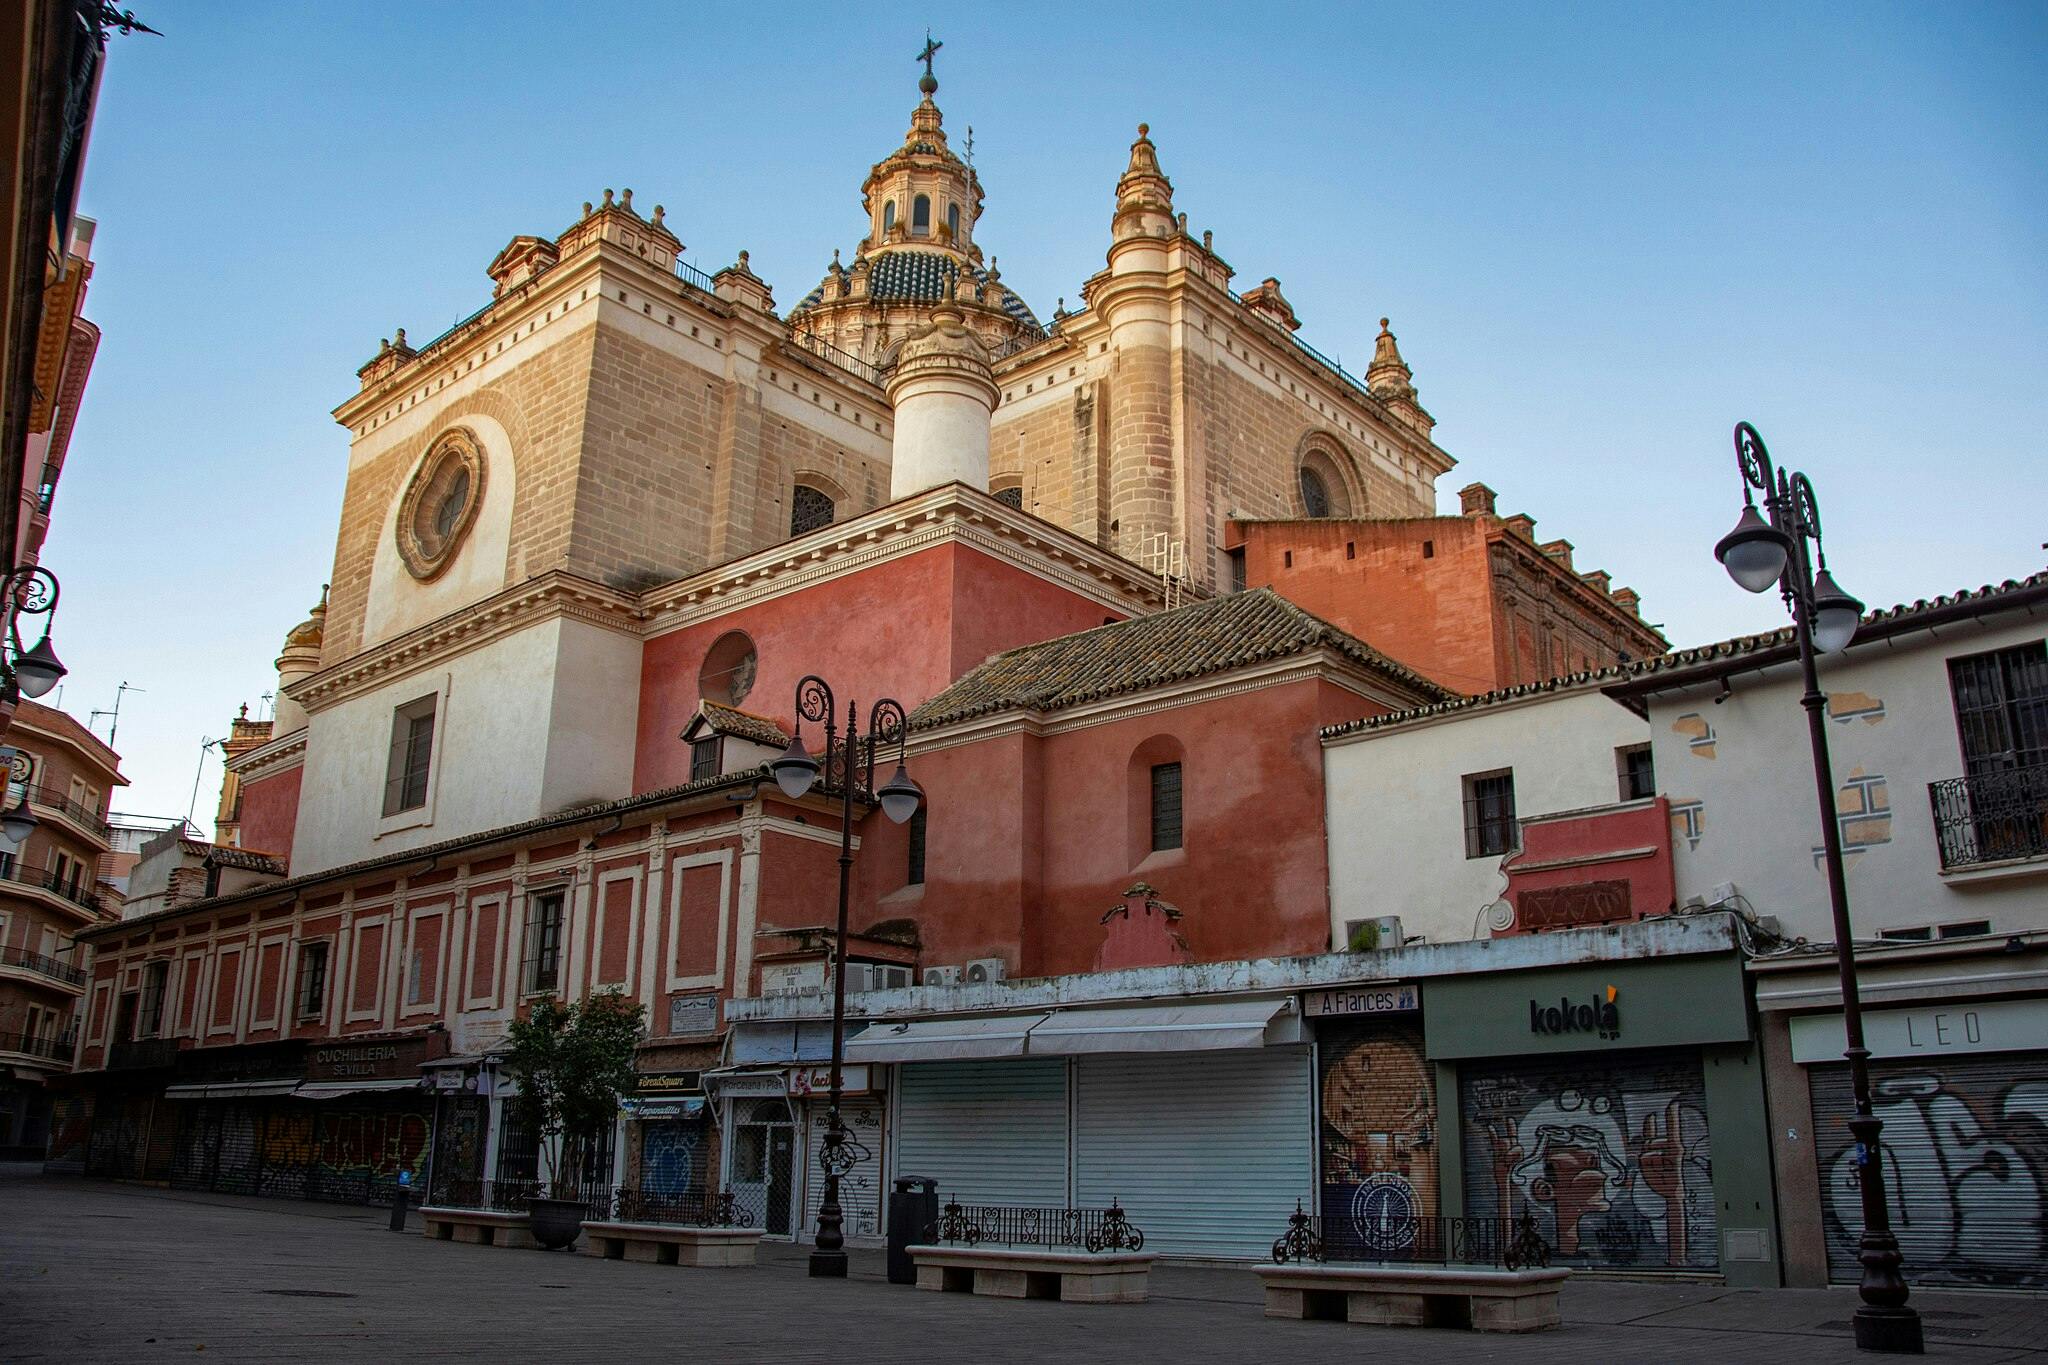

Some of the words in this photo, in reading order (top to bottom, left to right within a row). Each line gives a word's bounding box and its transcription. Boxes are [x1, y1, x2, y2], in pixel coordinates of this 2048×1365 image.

[1907, 1011, 1981, 1047] LEO
[1609, 1031, 1620, 1041] go
[333, 1063, 376, 1076] SEVILLA
[723, 1080, 761, 1091] Porcelana
